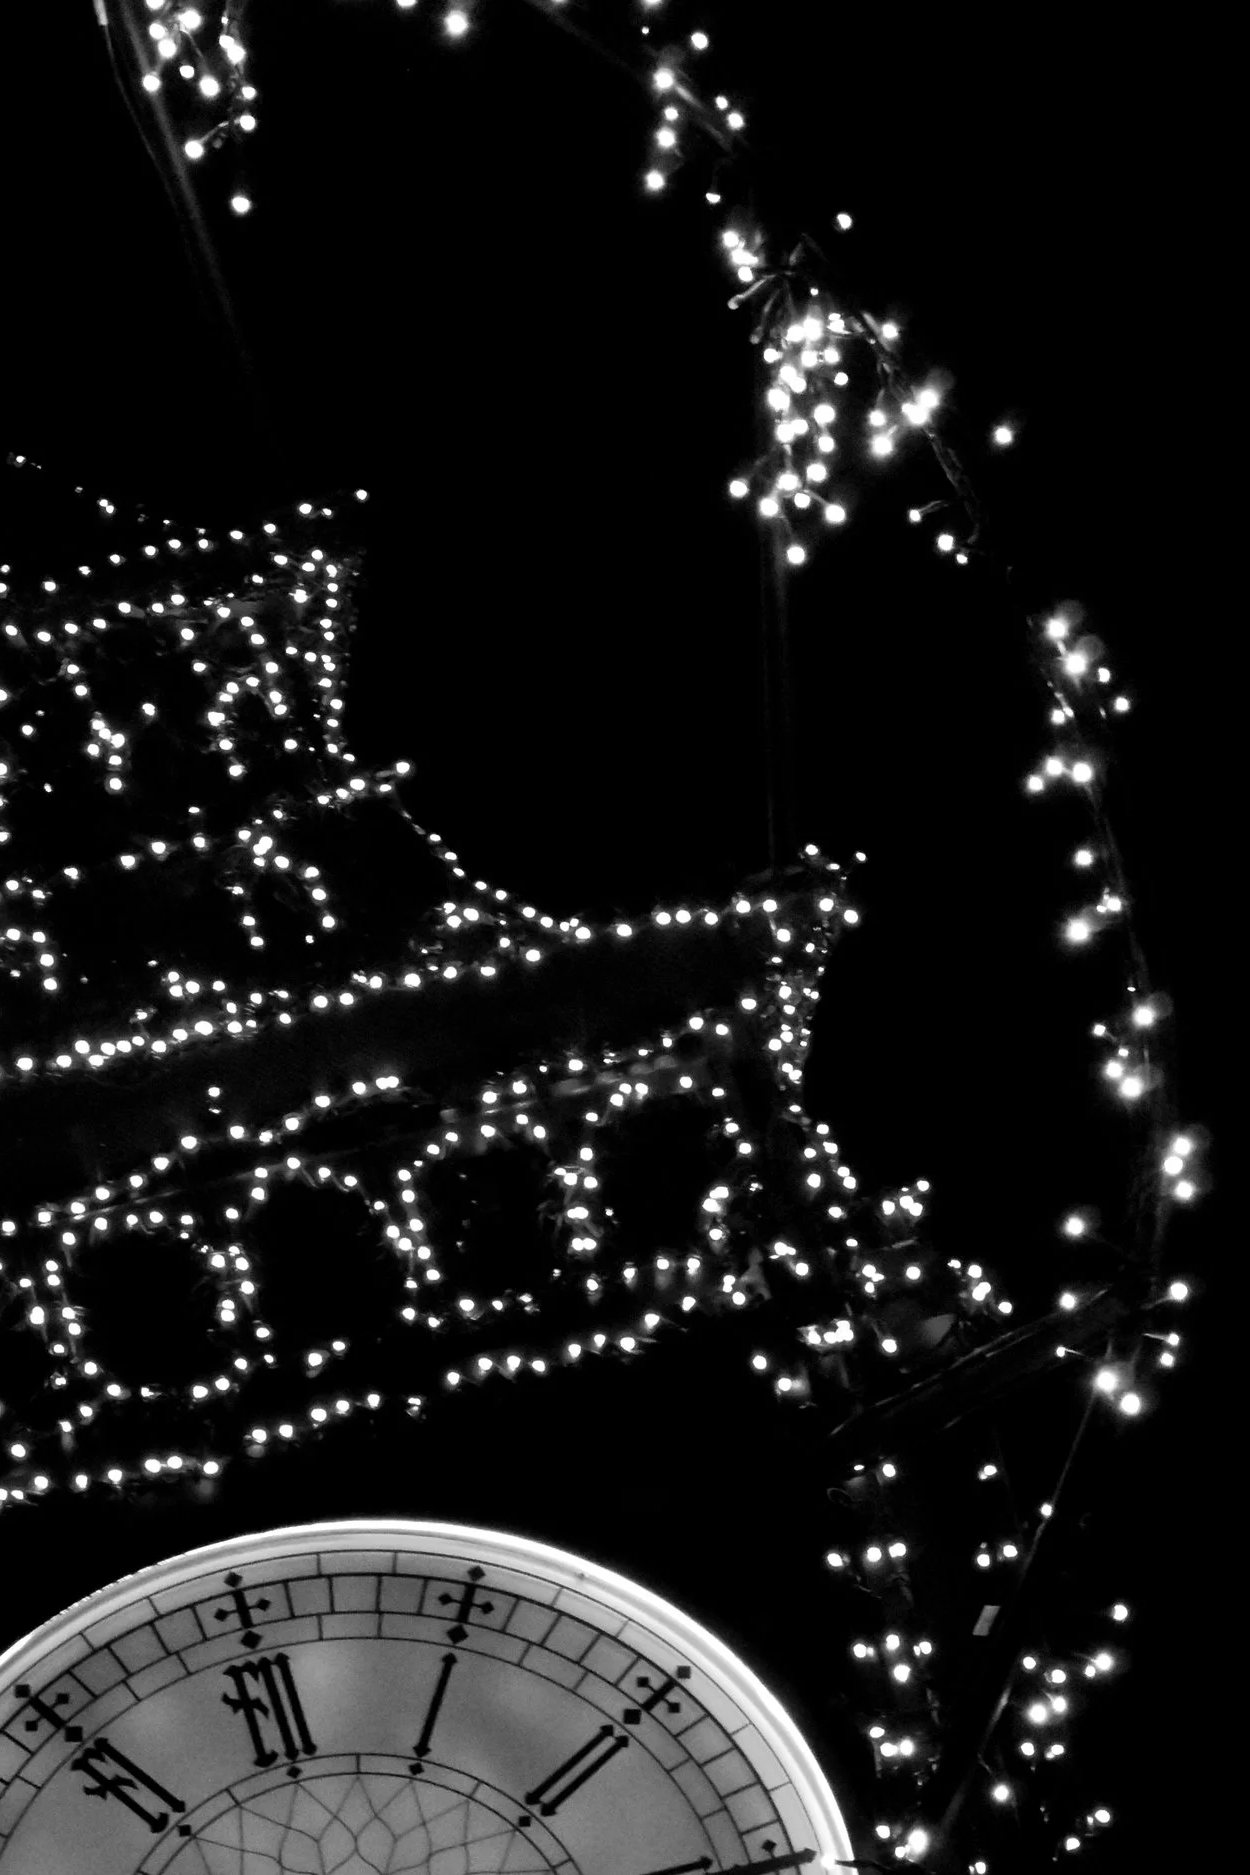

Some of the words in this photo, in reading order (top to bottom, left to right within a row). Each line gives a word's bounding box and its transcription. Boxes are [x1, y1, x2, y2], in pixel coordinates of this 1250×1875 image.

[222, 1653, 317, 1767] XII
[413, 1653, 457, 1758] I
[71, 1737, 186, 1833] XI
[525, 1725, 628, 1816] II
